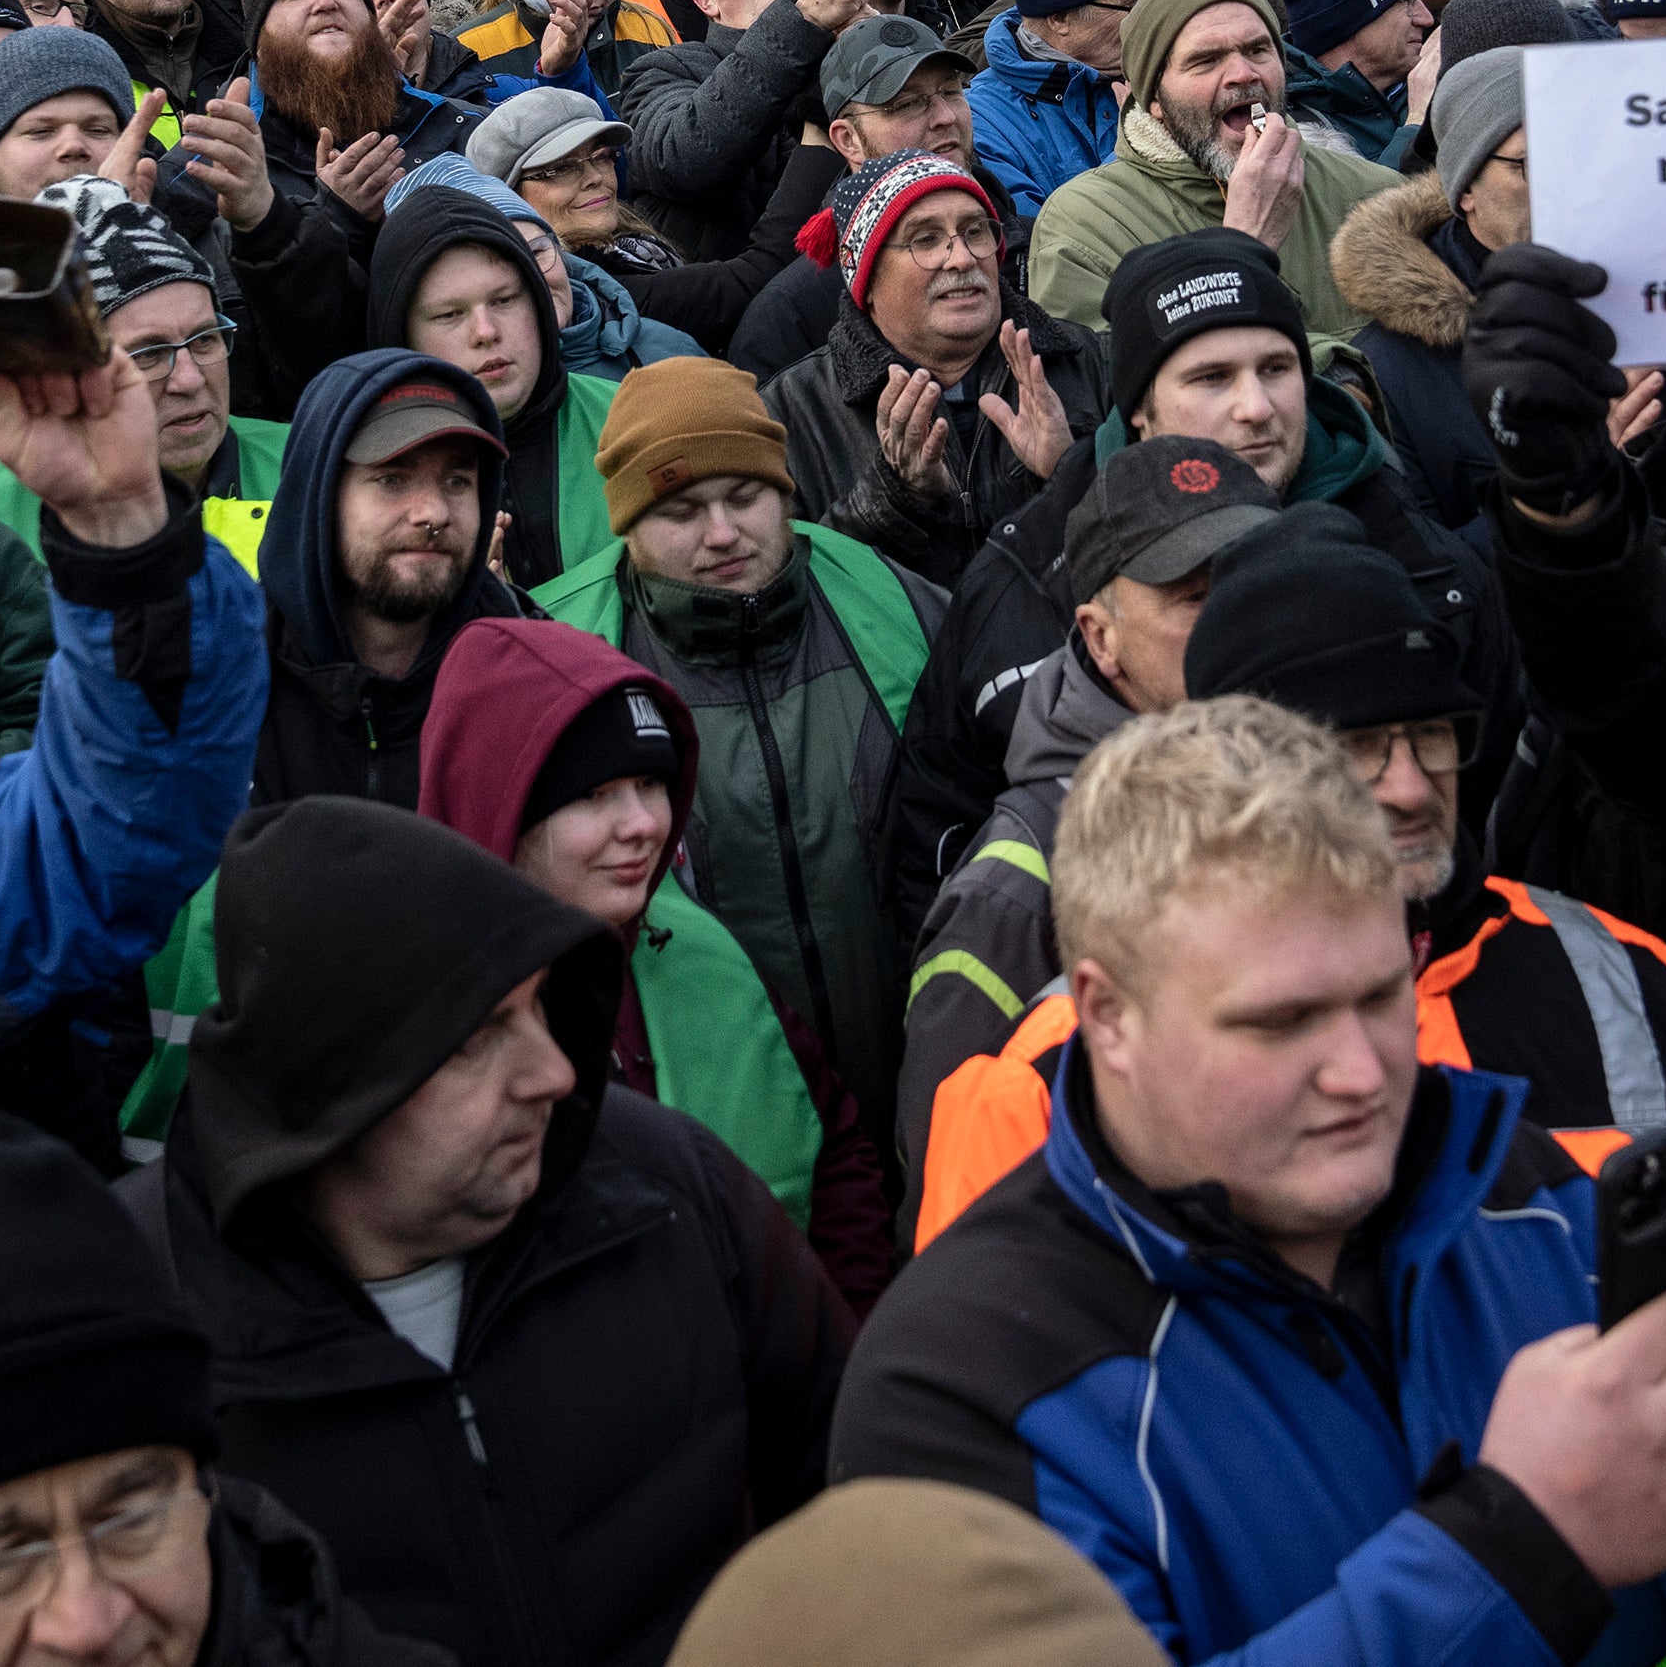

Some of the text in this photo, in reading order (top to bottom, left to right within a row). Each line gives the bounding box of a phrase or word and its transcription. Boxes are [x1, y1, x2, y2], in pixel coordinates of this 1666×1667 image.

[1156, 272, 1243, 310] ohne LANDWIRTE
[1163, 288, 1241, 325] keine ZUKUNFT
